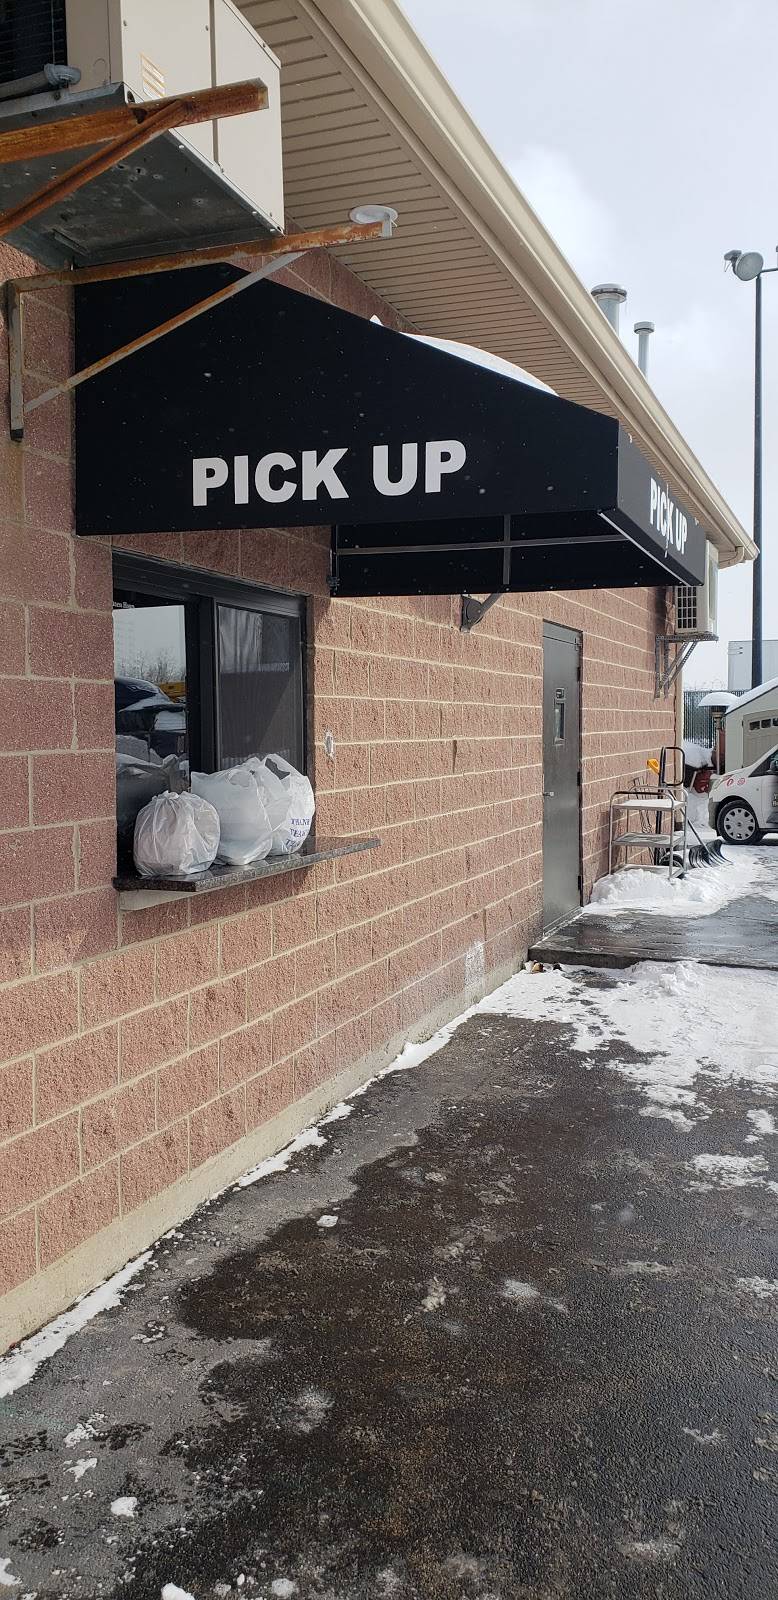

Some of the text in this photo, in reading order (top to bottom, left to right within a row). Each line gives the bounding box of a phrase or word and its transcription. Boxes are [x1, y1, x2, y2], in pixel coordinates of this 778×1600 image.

[193, 440, 467, 507] PICK UP
[650, 477, 688, 555] PICK UP
